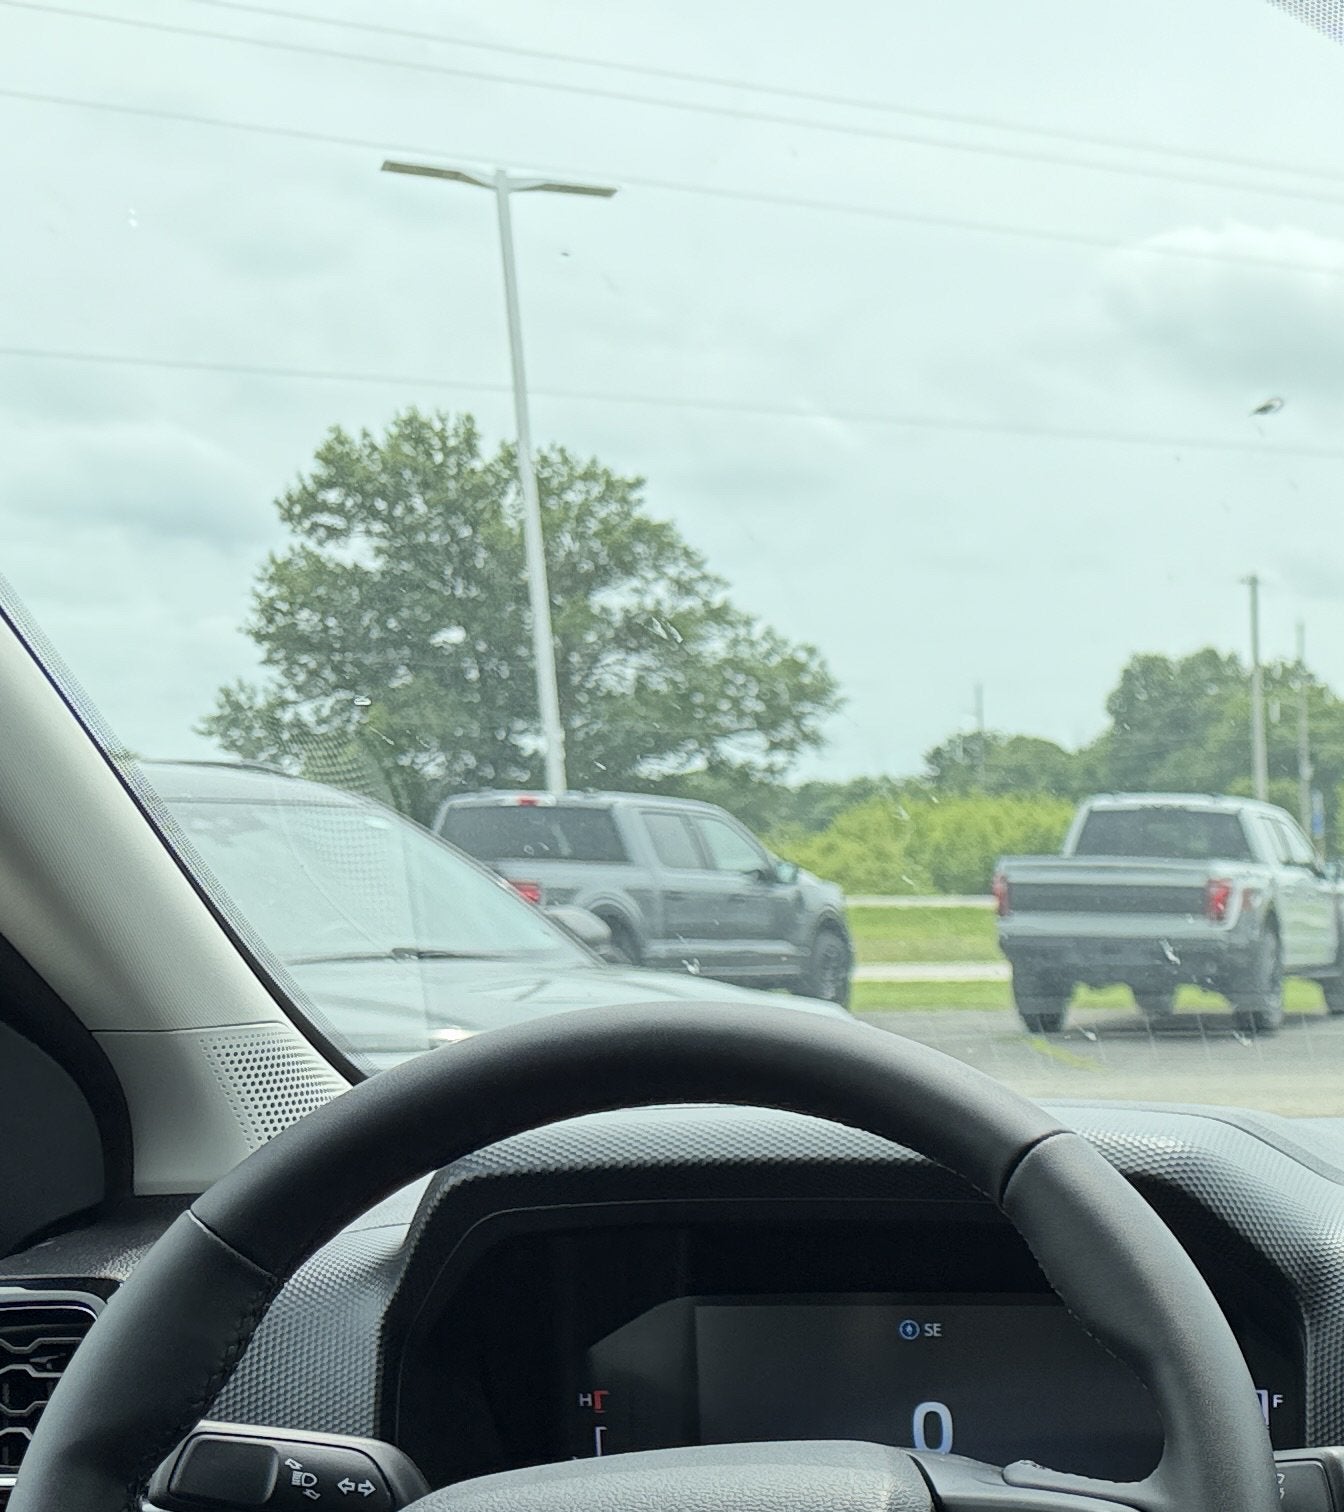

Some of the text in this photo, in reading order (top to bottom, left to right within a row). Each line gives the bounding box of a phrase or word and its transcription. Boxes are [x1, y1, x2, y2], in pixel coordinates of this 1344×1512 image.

[924, 1323, 942, 1337] SE
[579, 1393, 592, 1406] H
[1273, 1394, 1283, 1408] F
[913, 1402, 953, 1454] 0
